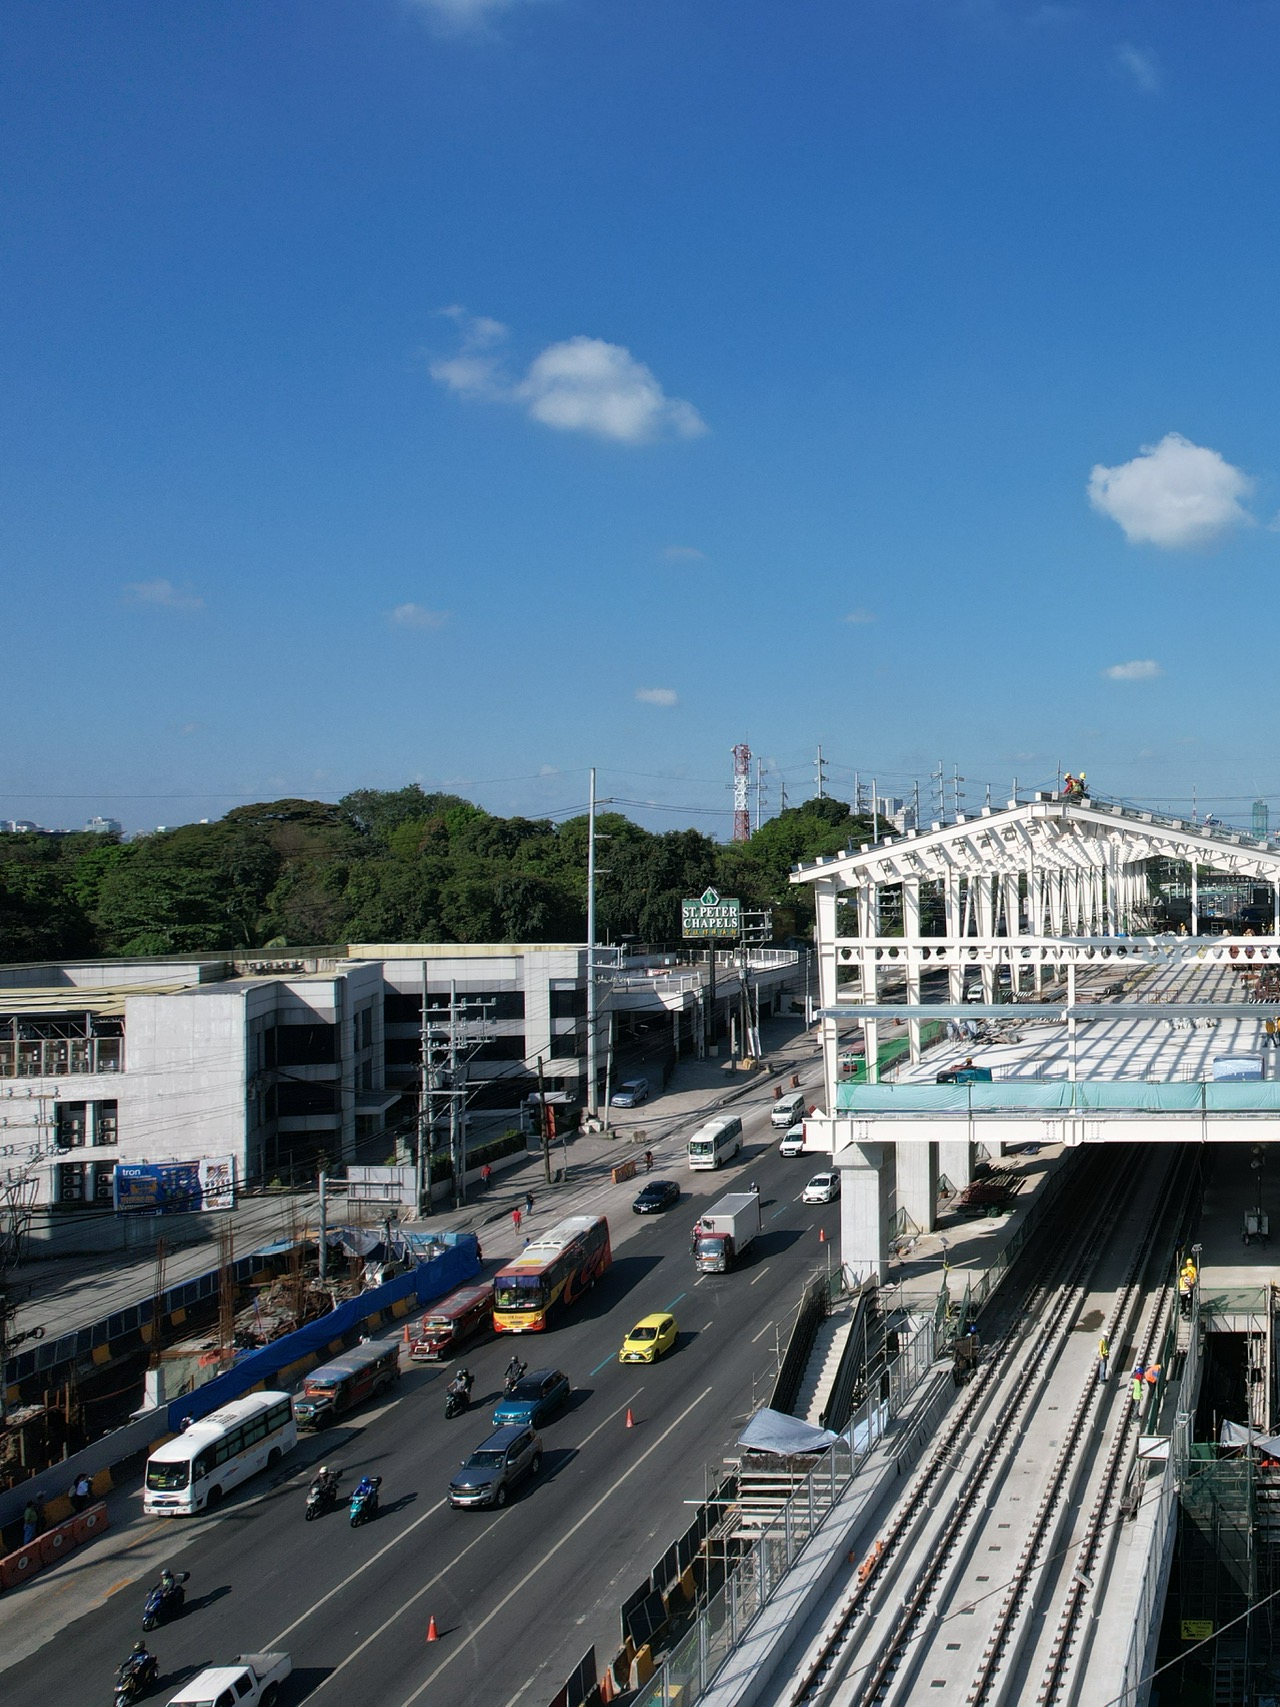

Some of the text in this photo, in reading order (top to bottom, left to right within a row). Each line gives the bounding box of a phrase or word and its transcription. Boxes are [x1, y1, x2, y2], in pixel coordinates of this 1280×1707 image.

[683, 907, 737, 918] ST. PETER
[683, 918, 738, 928] CHAPELS
